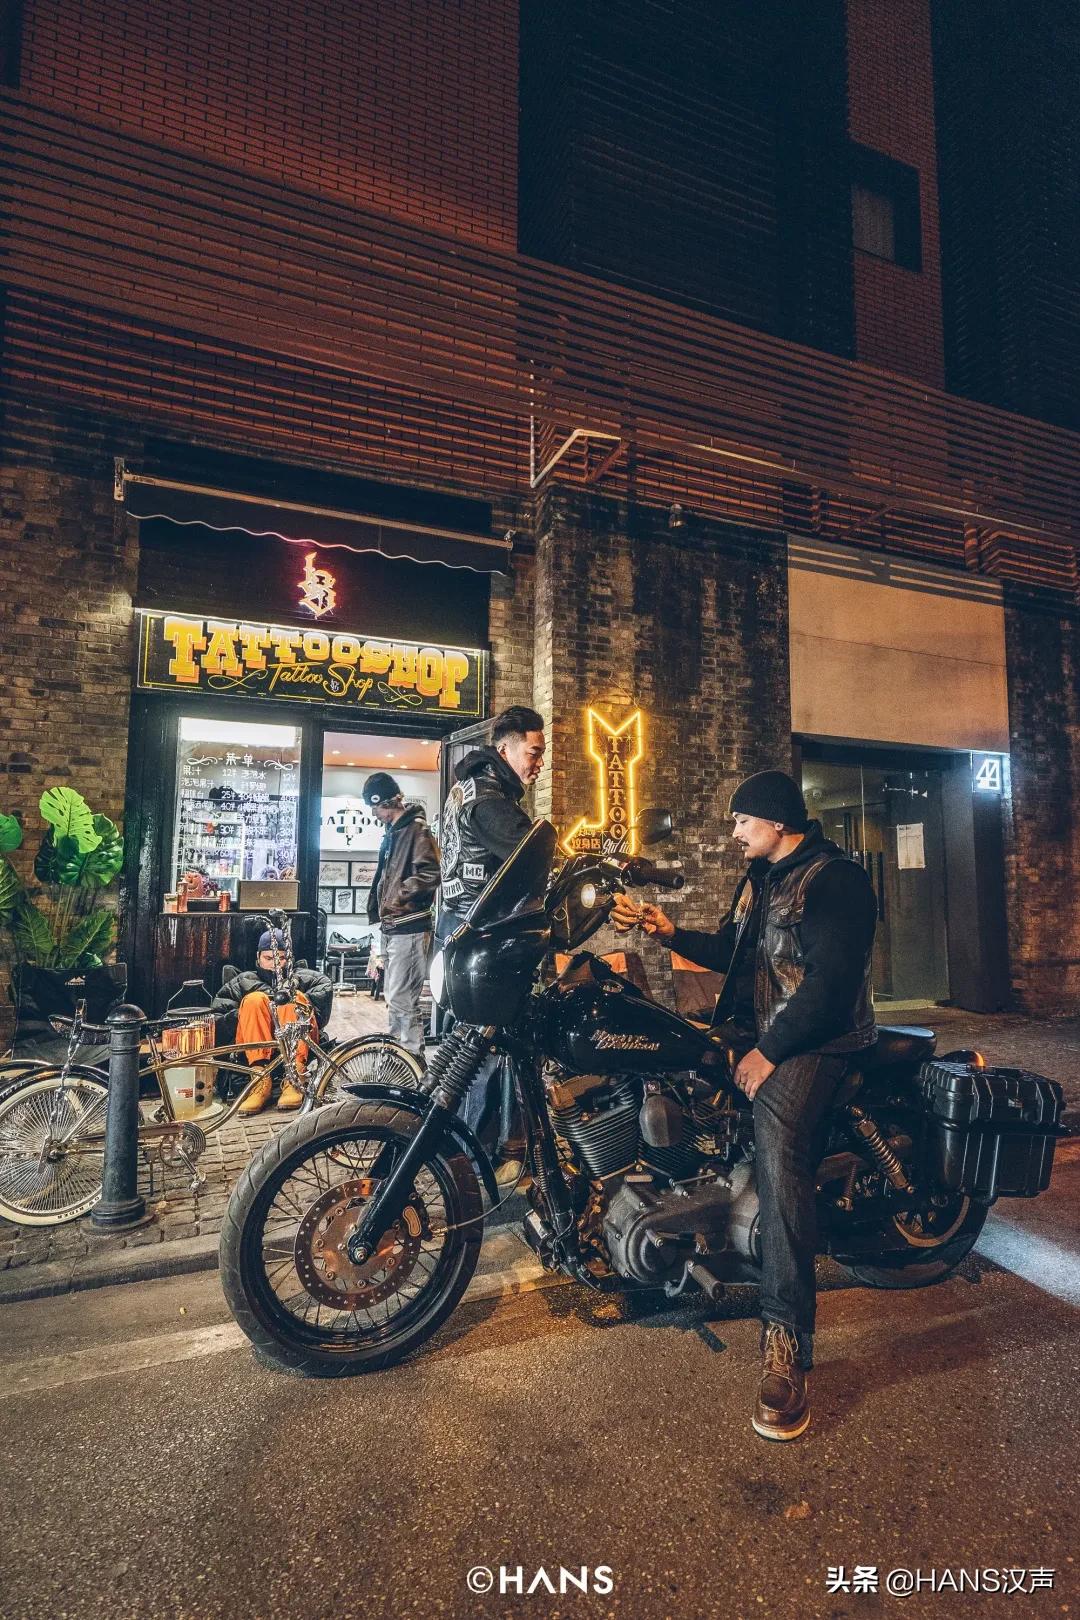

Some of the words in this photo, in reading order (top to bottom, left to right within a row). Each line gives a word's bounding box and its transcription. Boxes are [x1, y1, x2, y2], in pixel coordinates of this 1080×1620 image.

[267, 662, 324, 693] Tattoo
[322, 662, 374, 701] Shop
[607, 735, 627, 840] TATTOO
[465, 866, 482, 877] MC
